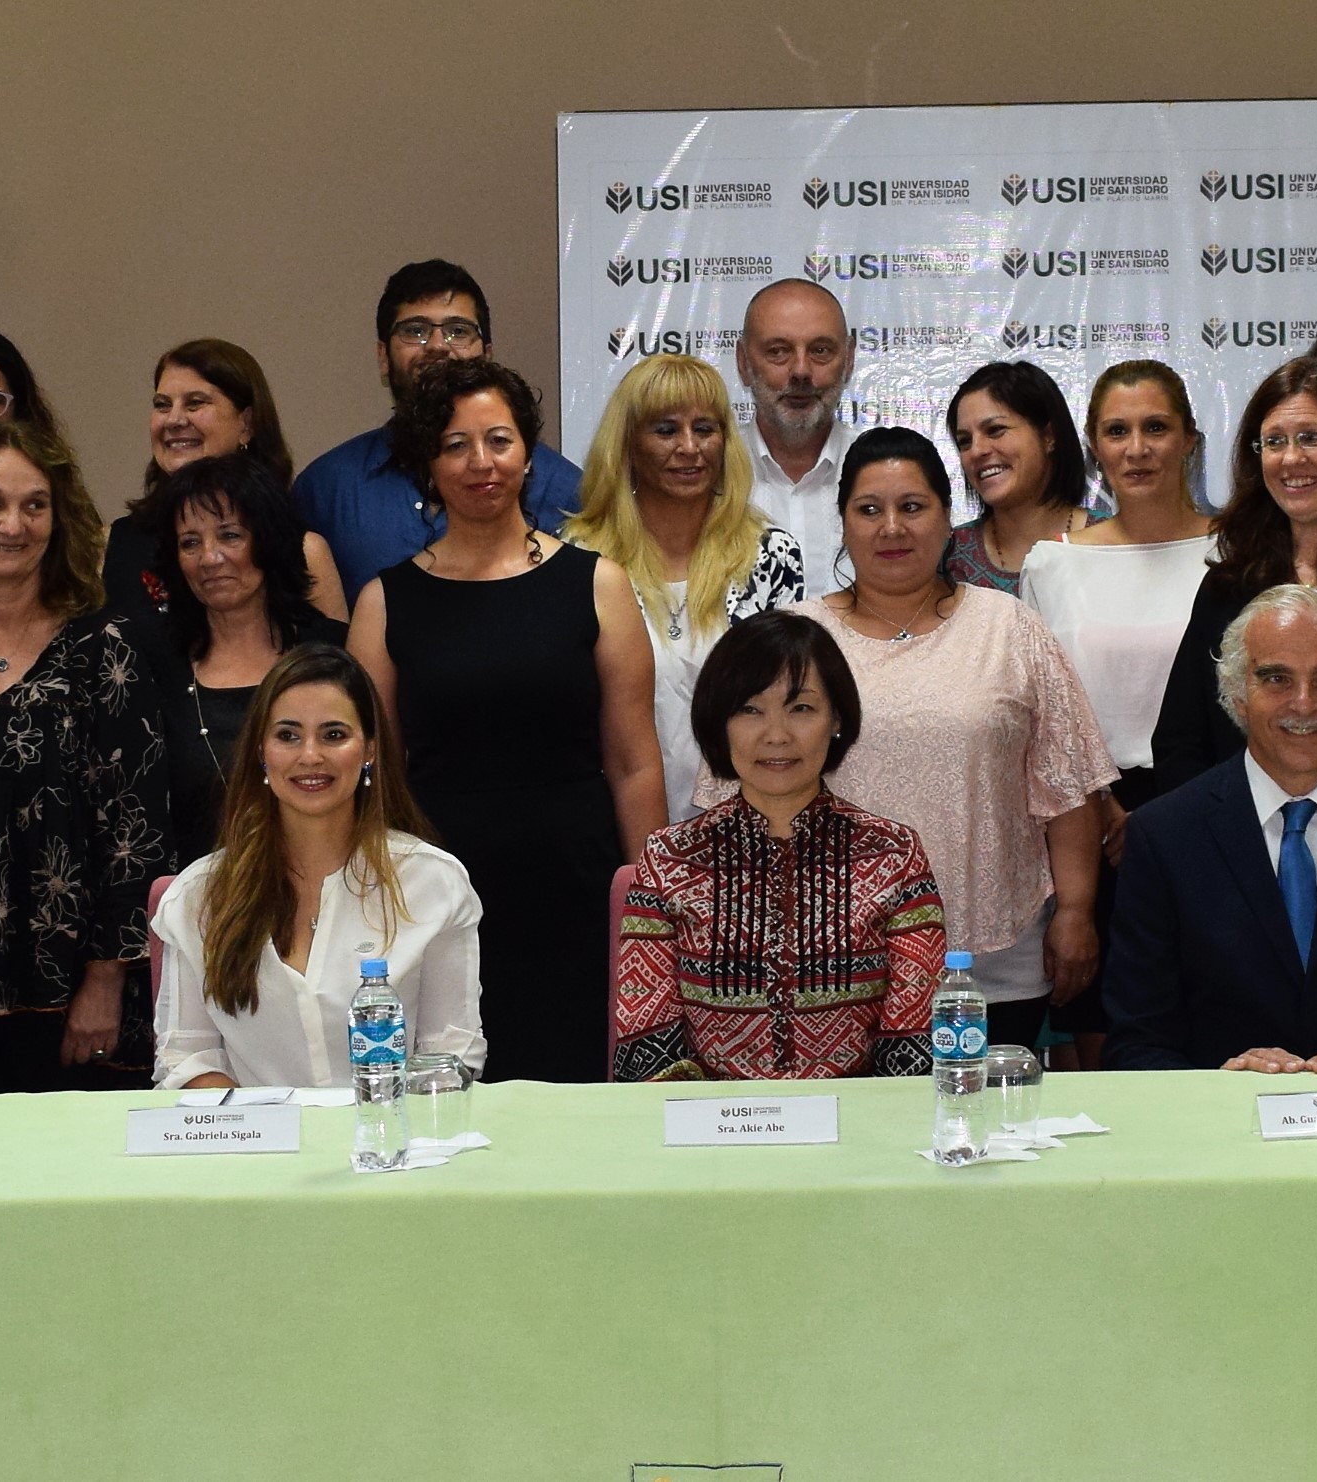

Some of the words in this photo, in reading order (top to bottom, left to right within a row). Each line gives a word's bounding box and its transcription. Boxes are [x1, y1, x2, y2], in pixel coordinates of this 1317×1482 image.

[891, 180, 969, 190] UNIVERSIDAD
[1091, 176, 1169, 187] UNIVERSIDAD
[1231, 174, 1284, 200] USI
[1289, 182, 1304, 192] DE
[694, 184, 772, 194] UNIVERSIDAD
[833, 181, 887, 207] USI
[891, 190, 907, 199] DE
[909, 189, 932, 199] SAN
[935, 188, 970, 199] ISIDRO
[1033, 178, 1086, 204] USI
[1091, 186, 1105, 196] DE
[1108, 186, 1131, 196] SAN
[1134, 185, 1169, 196] ISIDRO
[636, 185, 690, 211] USI
[694, 194, 709, 203] DE
[712, 193, 735, 203] SAN
[738, 192, 773, 203] ISIDRO
[1033, 251, 1087, 278] USI
[1231, 248, 1285, 274] USI
[637, 258, 691, 284] USI
[835, 254, 888, 281] USI
[1034, 324, 1087, 351] USI
[1233, 321, 1285, 346] USI
[639, 330, 691, 355] USI
[937, 1031, 951, 1039] bon
[935, 1039, 954, 1048] aqua
[731, 1107, 751, 1117] USI
[195, 1114, 215, 1124] USI
[1281, 1116, 1298, 1124] Ab.
[717, 1124, 737, 1134] Sra.
[739, 1124, 763, 1132] Akie
[765, 1122, 785, 1132] Abe
[163, 1132, 183, 1141] Sra.
[185, 1131, 229, 1140] Gabriela
[231, 1130, 261, 1141] Sigala
